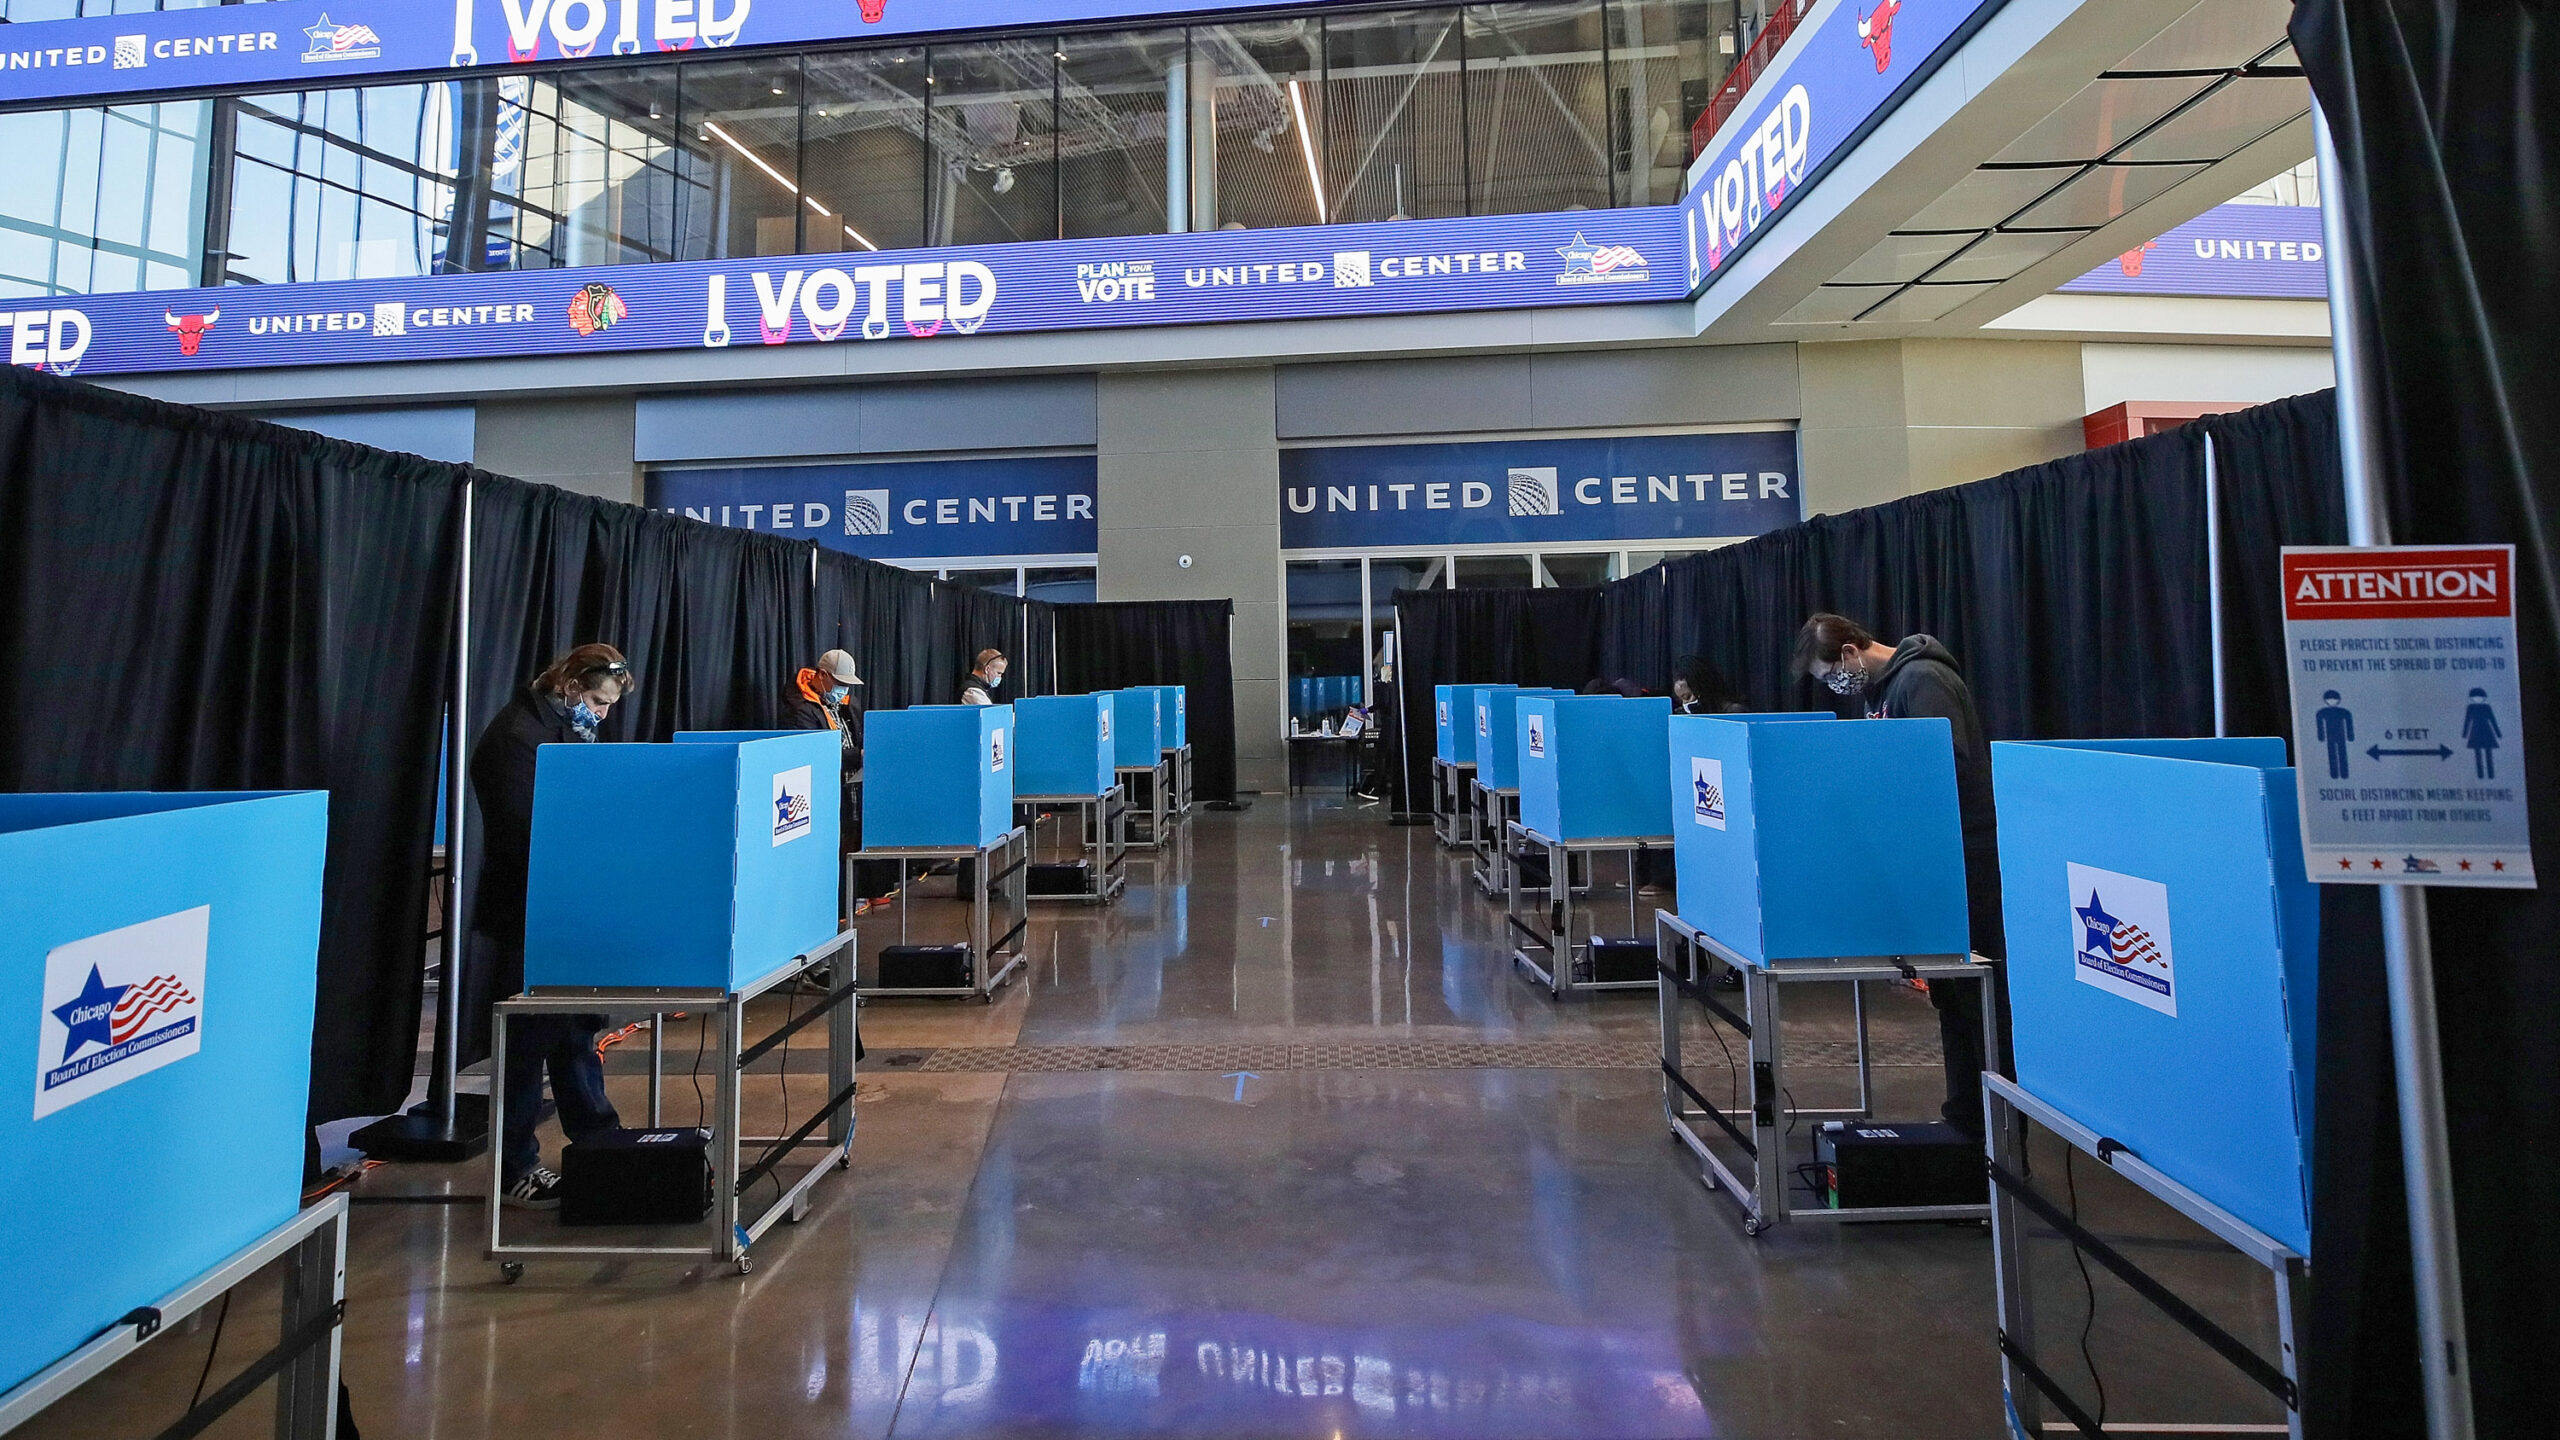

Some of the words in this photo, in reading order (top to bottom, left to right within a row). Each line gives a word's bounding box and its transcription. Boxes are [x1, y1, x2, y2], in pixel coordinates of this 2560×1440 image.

[453, 0, 474, 58] I
[153, 32, 278, 59] CENTER
[1687, 208, 1699, 285] I
[1702, 83, 1811, 256] VOTED
[2194, 238, 2322, 262] UNITED
[1077, 262, 1125, 279] PLAN
[1128, 264, 1152, 273] YOUR
[1184, 262, 1325, 288] UNITED
[1380, 251, 1527, 278] CENTER
[706, 274, 729, 338] I
[751, 261, 997, 329] VOTED
[1076, 277, 1156, 303] VOTE
[249, 313, 366, 337] UNITED
[412, 303, 534, 328] CENTER
[1288, 481, 1492, 513] UNITED
[1574, 471, 1791, 504] CENTER
[650, 502, 831, 529] NITED
[903, 494, 1095, 525] CENTER
[2296, 570, 2497, 600] ATTENTION
[2300, 638, 2337, 651] PLEASE
[2341, 638, 2390, 651] PRACTICE
[2394, 638, 2431, 651] SOCIAL
[2435, 637, 2504, 650] DISTANCING
[2303, 659, 2317, 671] TO
[2319, 659, 2364, 671] PREVENT
[2367, 658, 2386, 671] THE
[2390, 657, 2431, 671] SPREAD
[2434, 657, 2449, 670] OF
[2452, 657, 2505, 670] COVID-19
[2385, 729, 2394, 740] 6
[2398, 728, 2430, 740] FEET
[2320, 788, 2357, 801] SOCIAL
[2361, 788, 2424, 801] DISTANCING
[2427, 788, 2464, 801] MEANS
[2467, 788, 2513, 801] KEEPING
[2342, 809, 2349, 821] 6
[2353, 809, 2376, 821] FEET
[2379, 809, 2413, 821] APART
[2417, 809, 2446, 821] FROM
[2450, 809, 2491, 821] OTHERS
[2086, 916, 2110, 935] Chicago
[2081, 953, 2098, 967] Board
[2103, 961, 2124, 977] Election
[2125, 969, 2167, 992] Commissioners
[70, 1001, 112, 1026] Chicago
[50, 1064, 79, 1086] Board
[80, 1061, 92, 1075] of
[91, 1046, 127, 1070] Election
[128, 1022, 190, 1053] Commissioners
